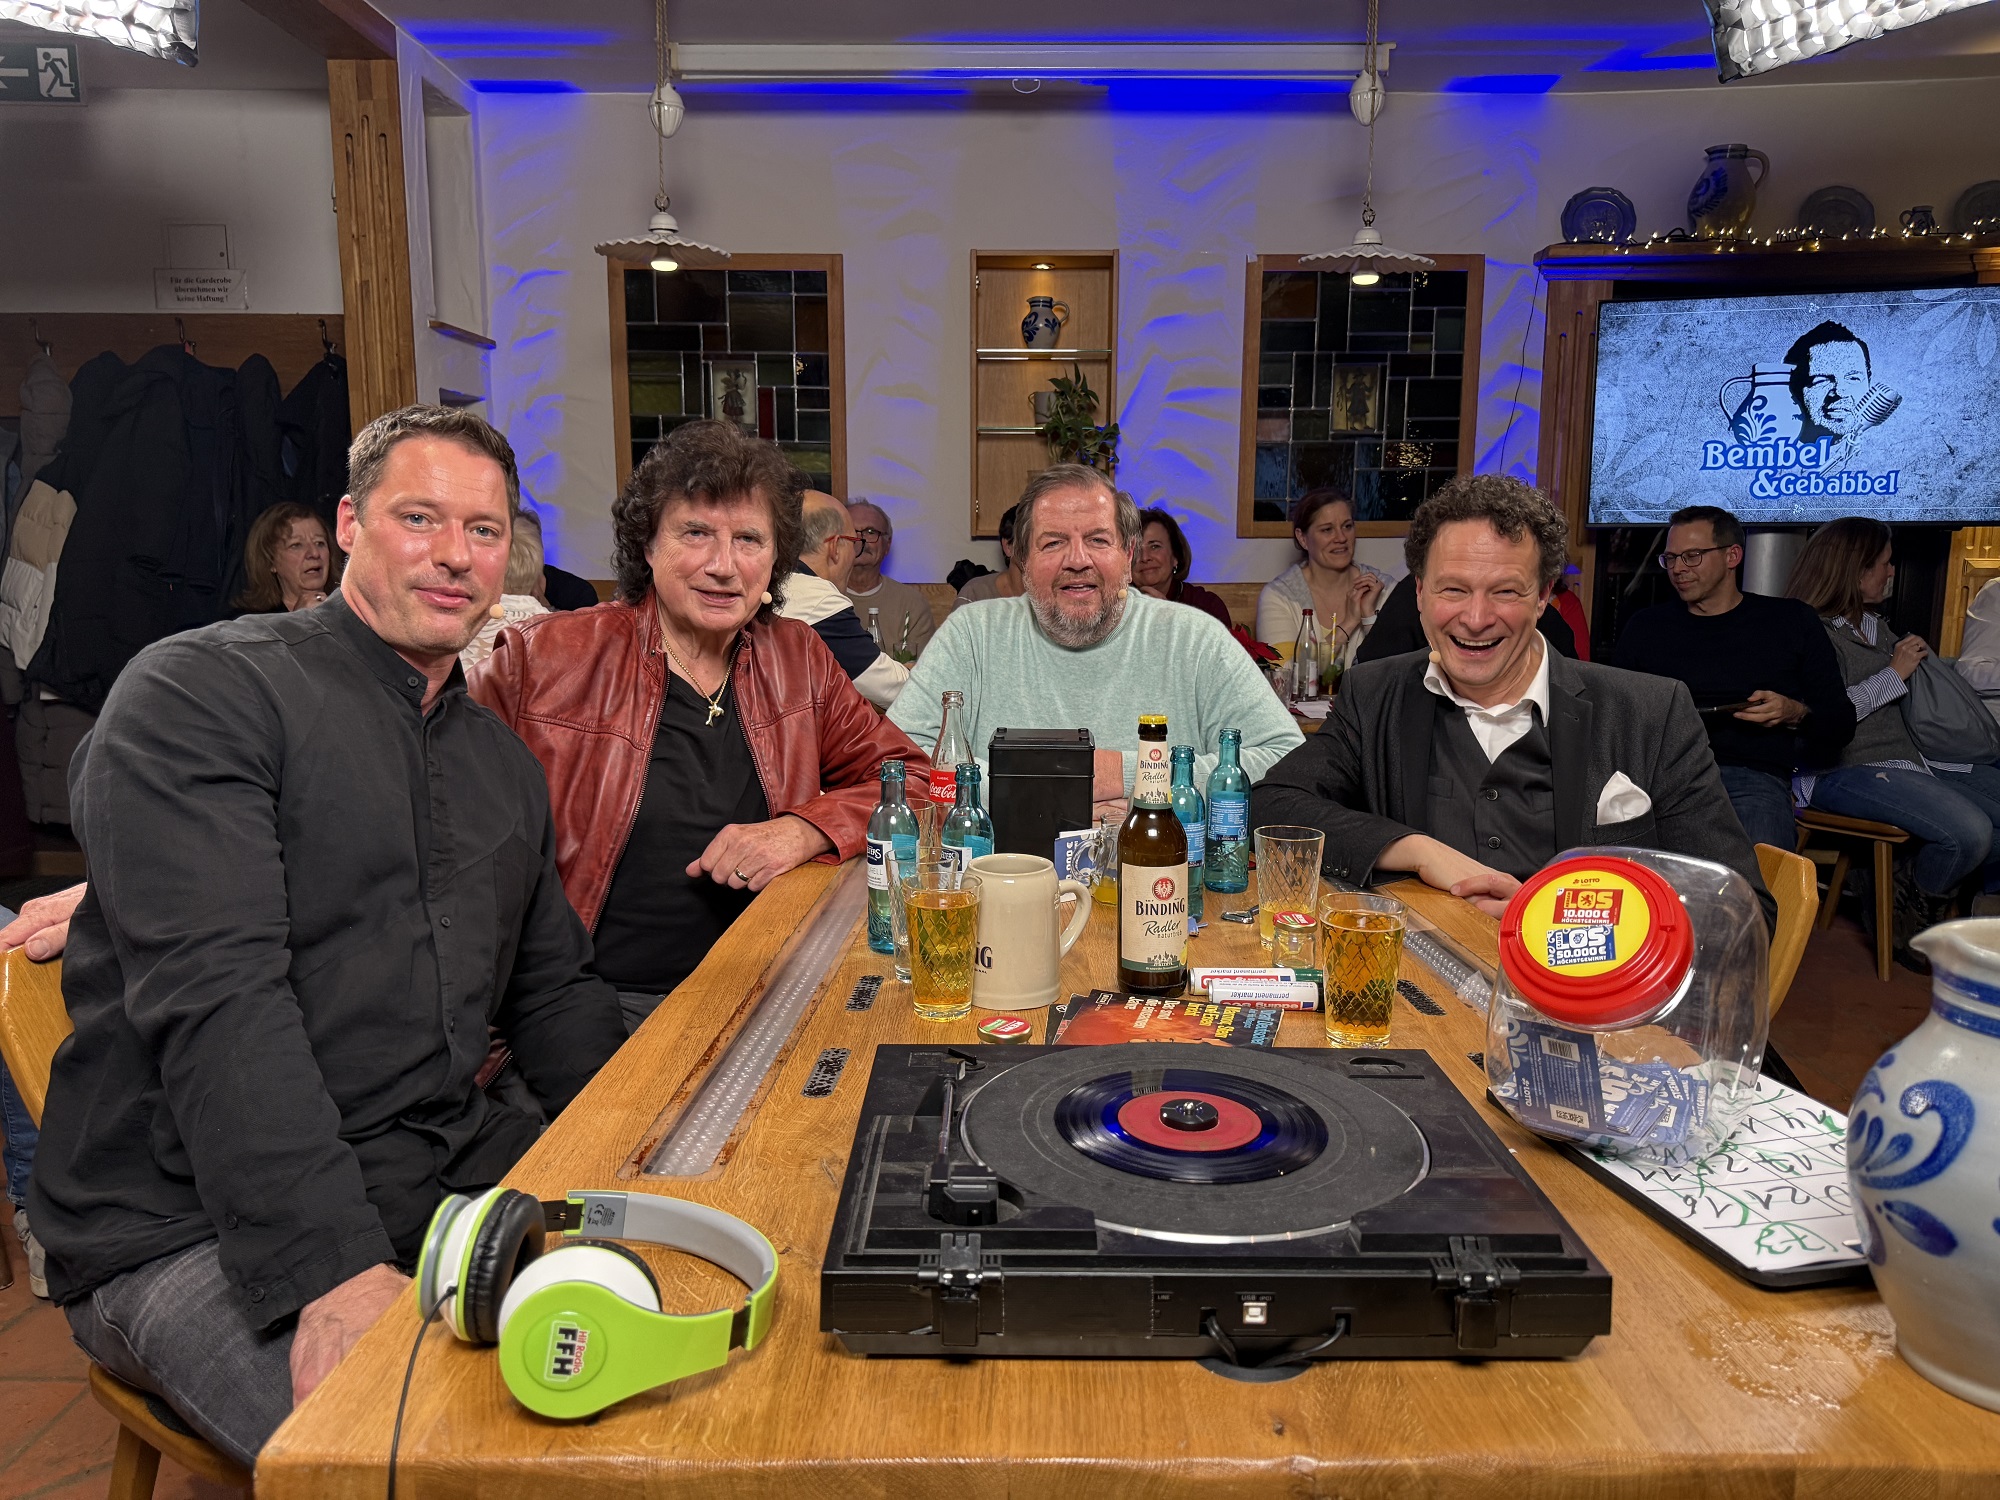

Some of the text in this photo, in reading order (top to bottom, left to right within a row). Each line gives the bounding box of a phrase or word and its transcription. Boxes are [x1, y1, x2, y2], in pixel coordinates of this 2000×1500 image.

[196, 295, 224, 303] Haftung
[1703, 437, 1831, 469] Bembel
[1140, 760, 1169, 769] BINDING
[1142, 772, 1166, 781] Radler
[1136, 899, 1185, 915] BINDING
[1564, 890, 1614, 909] LOS
[1563, 909, 1600, 918] 10.000
[1602, 910, 1610, 918] €
[1143, 920, 1181, 936] Radler
[1556, 927, 1606, 950] LOS
[1556, 947, 1598, 959] 50.000
[1599, 946, 1606, 955] €
[1556, 956, 1607, 965] HÖCHSTGEWINN!
[1254, 991, 1290, 999] permanent
[1157, 1000, 1181, 1021] Das sind
[1525, 1087, 1533, 1107] LOTTO
[552, 1326, 579, 1376] FFH
[573, 1330, 588, 1375] Hit Radio
